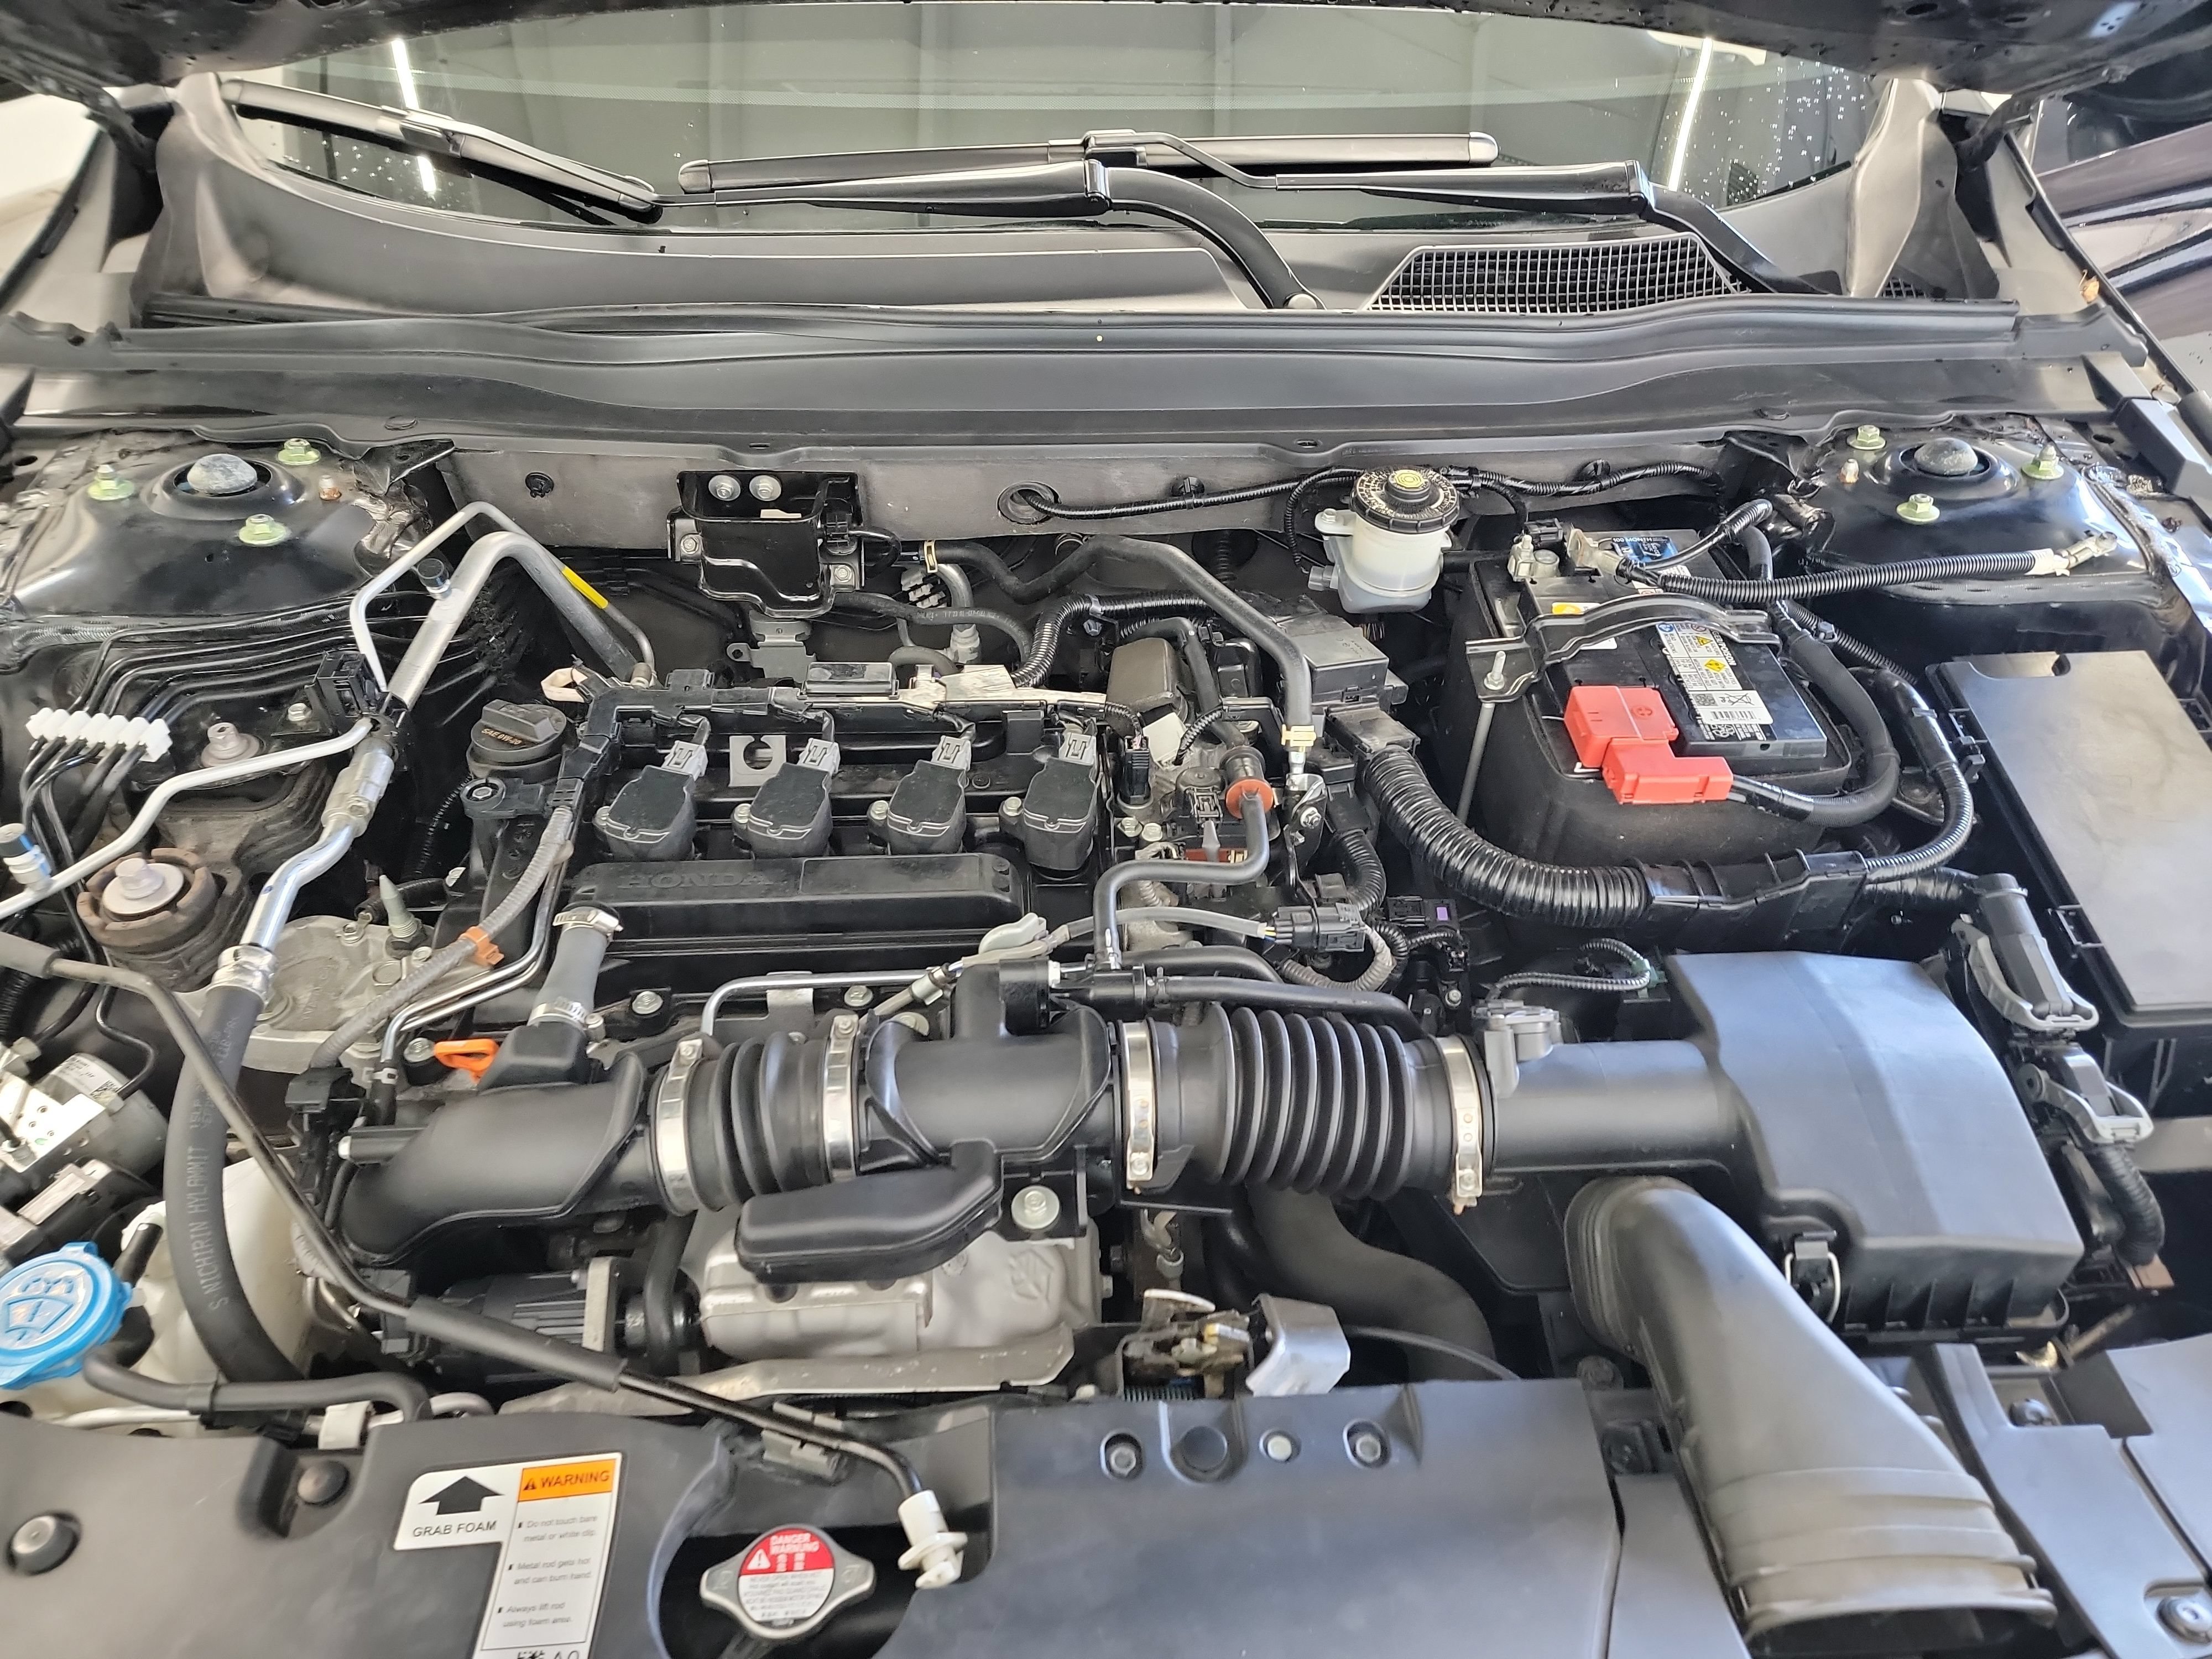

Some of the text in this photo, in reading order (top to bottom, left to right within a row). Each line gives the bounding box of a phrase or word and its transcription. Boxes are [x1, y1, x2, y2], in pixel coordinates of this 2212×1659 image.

[481, 728, 523, 745] SAE 0W-20
[617, 872, 774, 889] HONDA
[189, 1220, 223, 1295] NICHIRIN
[541, 1470, 611, 1488] WARNING
[413, 1520, 498, 1537] GRAB FOAM
